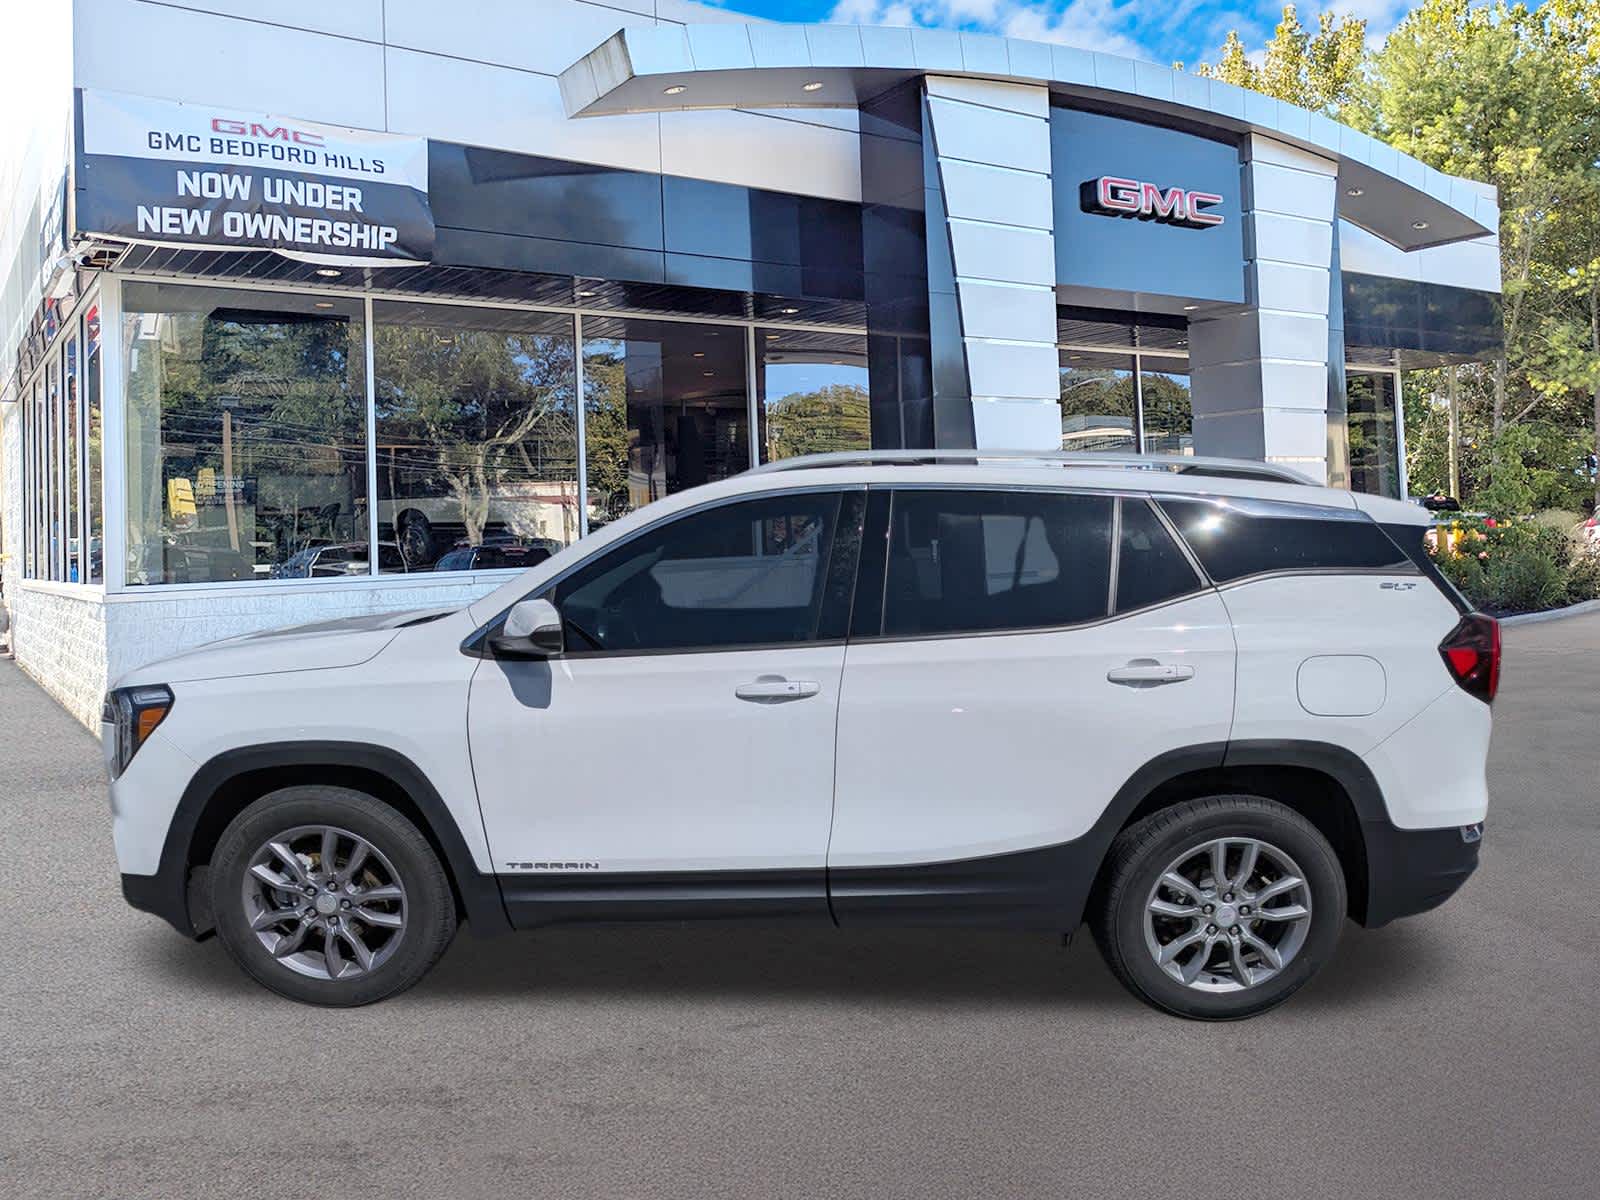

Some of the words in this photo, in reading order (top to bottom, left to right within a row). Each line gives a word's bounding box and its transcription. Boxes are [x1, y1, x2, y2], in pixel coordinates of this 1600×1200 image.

[148, 131, 201, 153] GMC
[210, 138, 316, 165] BEDFORD
[324, 153, 385, 174] HILLS
[211, 118, 326, 148] GMC
[177, 170, 252, 201] NOW
[263, 177, 364, 213] UNDER
[1097, 175, 1225, 225] GMC
[137, 205, 212, 236] NEW
[223, 211, 398, 250] OWNERSHIP
[1379, 582, 1417, 591] SLT
[506, 862, 600, 870] TERRAIN
